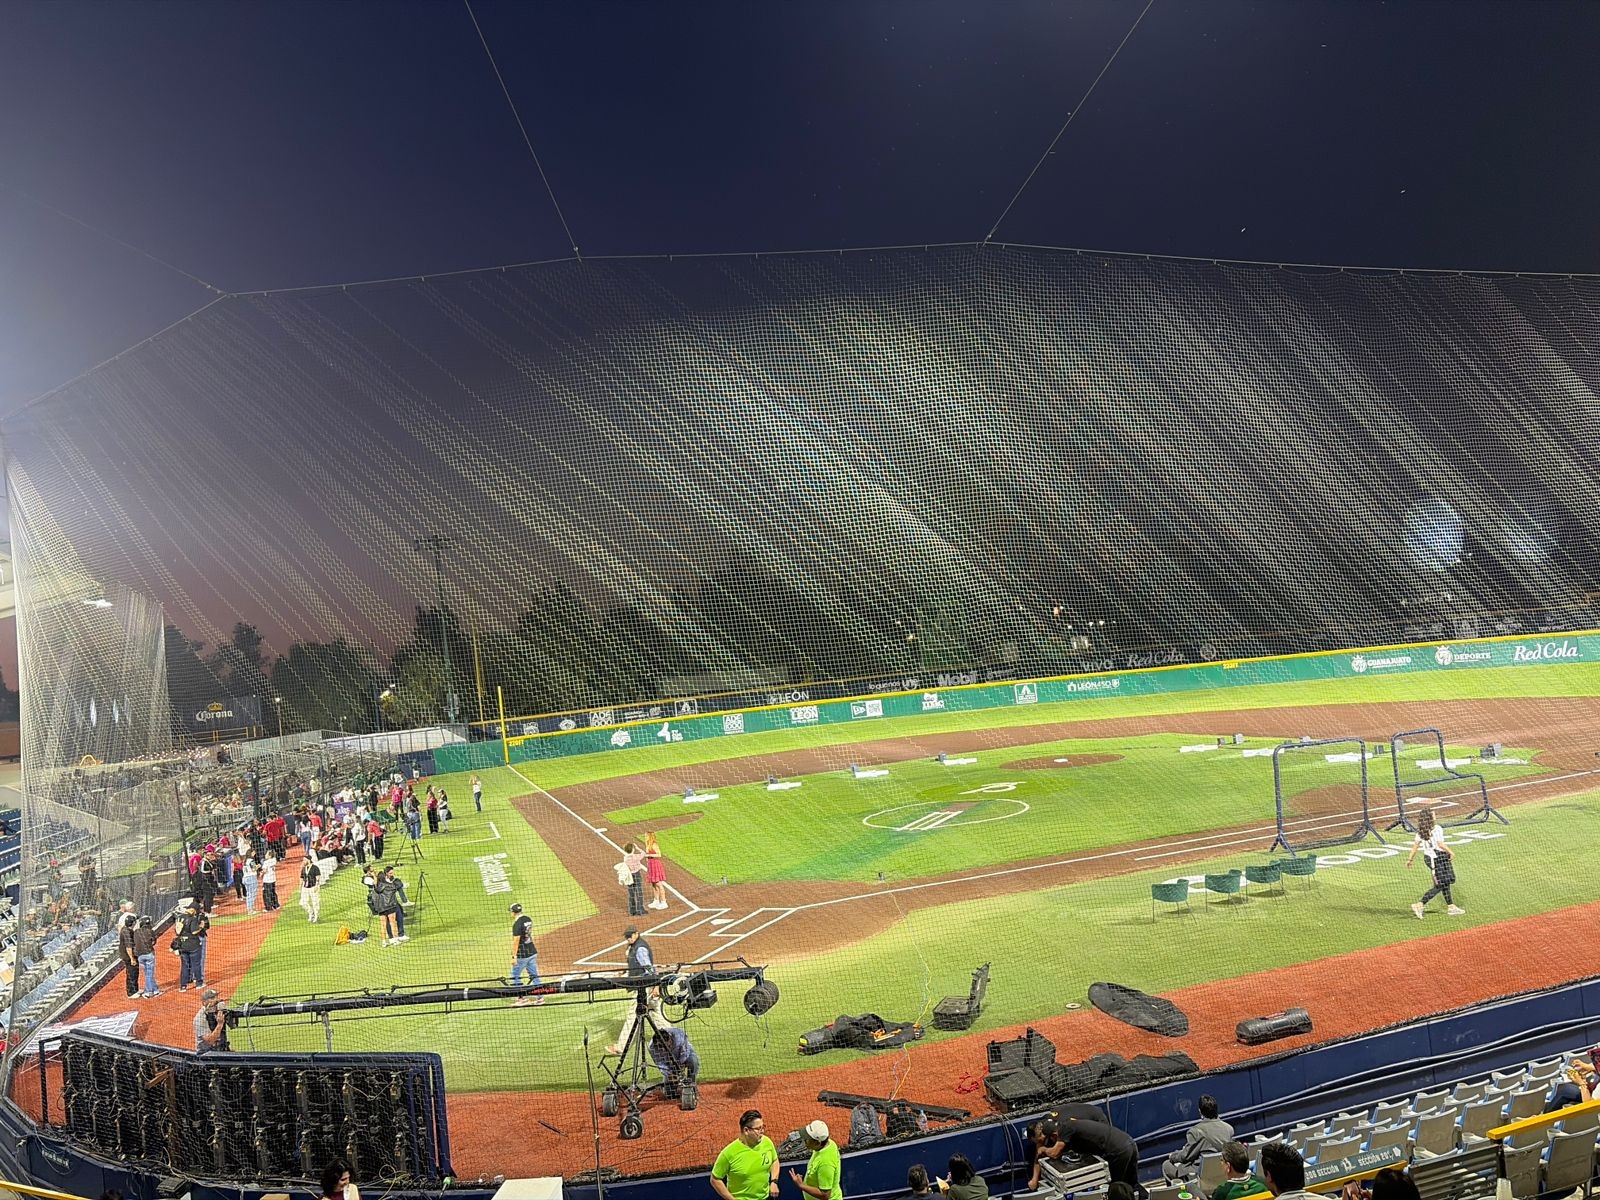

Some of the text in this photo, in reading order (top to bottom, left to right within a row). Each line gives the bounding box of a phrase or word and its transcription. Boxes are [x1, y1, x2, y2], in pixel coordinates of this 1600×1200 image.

[1454, 652, 1492, 660] DEPORTE
[1514, 640, 1579, 661] Red Cola
[1367, 656, 1412, 667] GUANAJUATO
[196, 710, 233, 723] Corona
